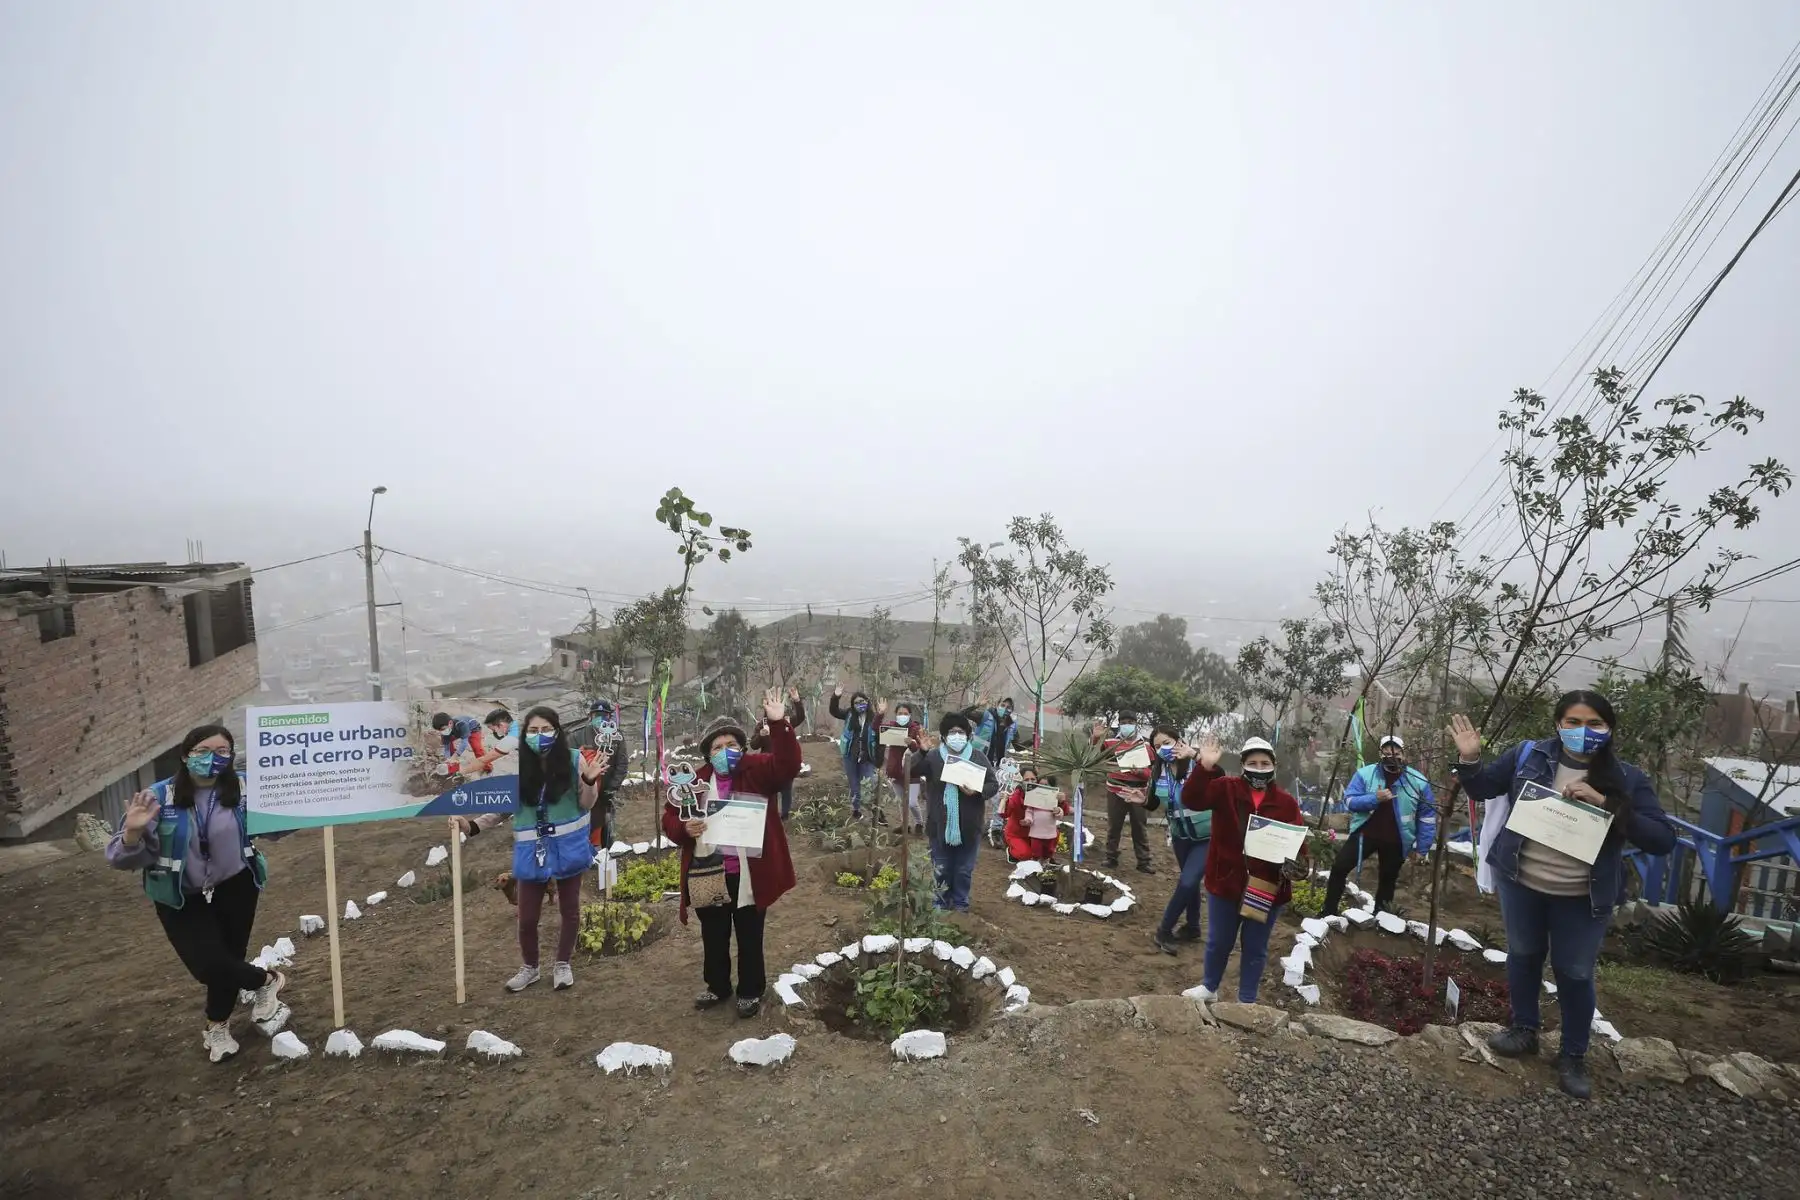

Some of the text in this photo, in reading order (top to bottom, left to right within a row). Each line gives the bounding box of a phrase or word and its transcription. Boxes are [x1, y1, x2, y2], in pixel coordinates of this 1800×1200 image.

[260, 715, 328, 727] Bienvenidos
[259, 725, 407, 748] Bosque urbano
[258, 745, 413, 767] en el cerro Papa
[259, 774, 288, 782] Espacio
[289, 771, 306, 779] dará
[307, 769, 338, 777] oxígeno,
[339, 767, 365, 775] sombra
[281, 780, 312, 788] servicios
[313, 776, 357, 785] ambientales
[307, 785, 355, 795] consecuencias
[367, 781, 392, 789] cambio
[475, 794, 512, 805] LIMA
[1542, 805, 1578, 823] CERTIFICADO
